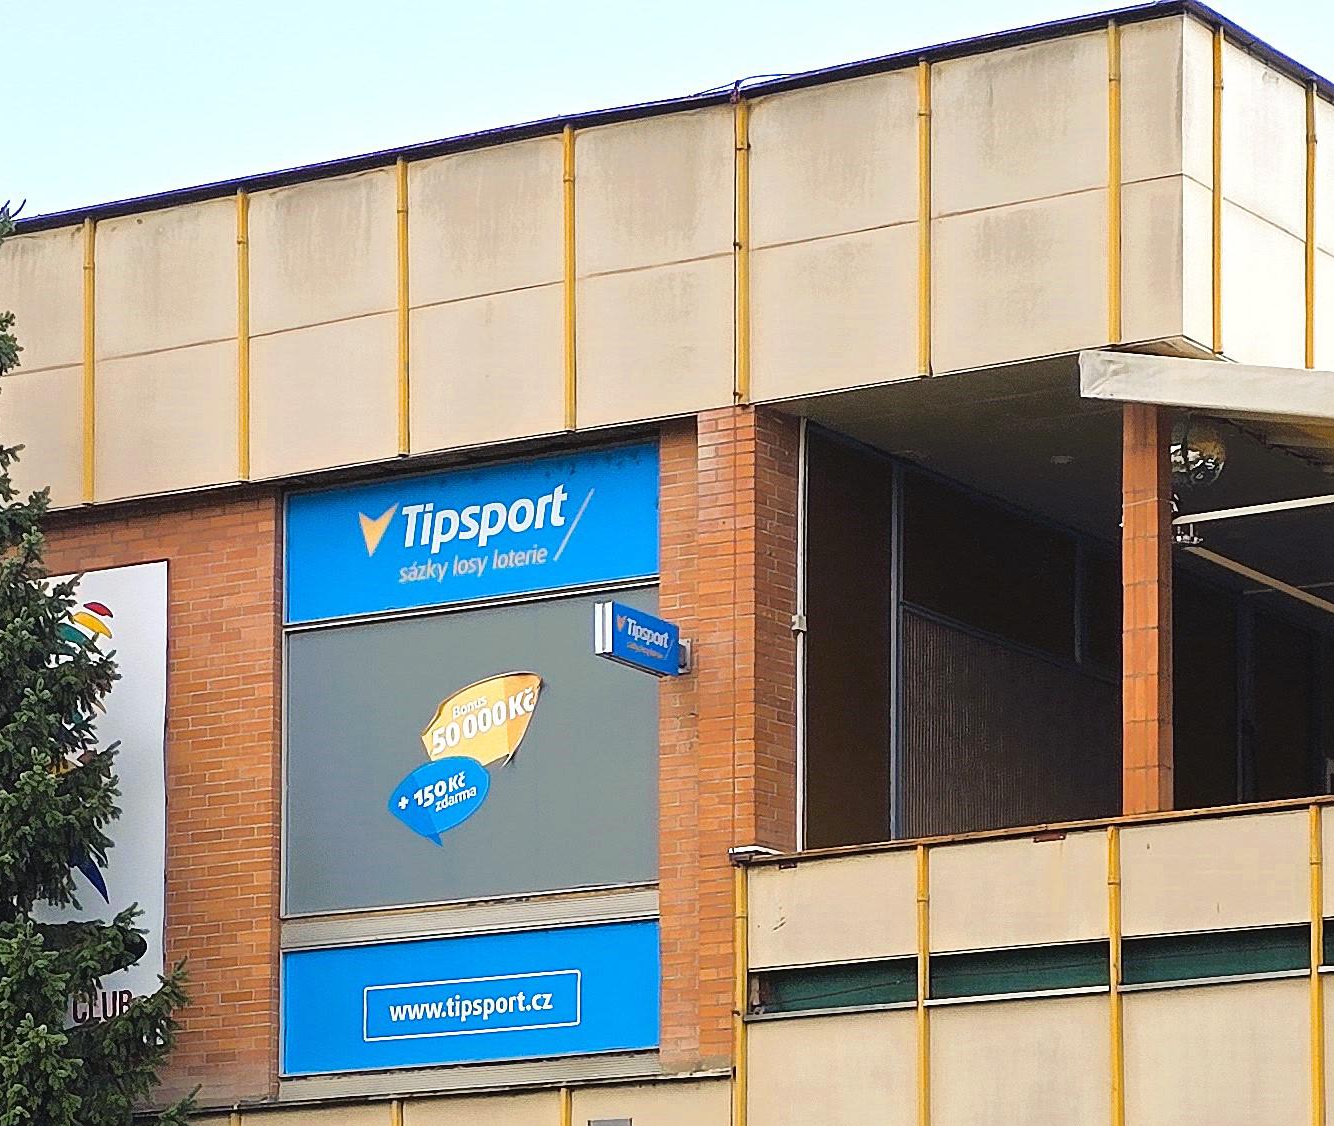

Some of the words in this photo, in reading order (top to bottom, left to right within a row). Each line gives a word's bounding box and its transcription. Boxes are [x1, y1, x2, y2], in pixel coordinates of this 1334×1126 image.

[402, 485, 568, 554] Tipsport
[399, 557, 449, 584] sázky
[452, 552, 488, 578] losy
[492, 543, 549, 569] loterie
[627, 617, 669, 649] Tipsport
[452, 695, 488, 717] Bonus
[413, 779, 447, 808] 150
[435, 786, 478, 813] zdarma
[389, 991, 554, 1022] www.tipsport.cz
